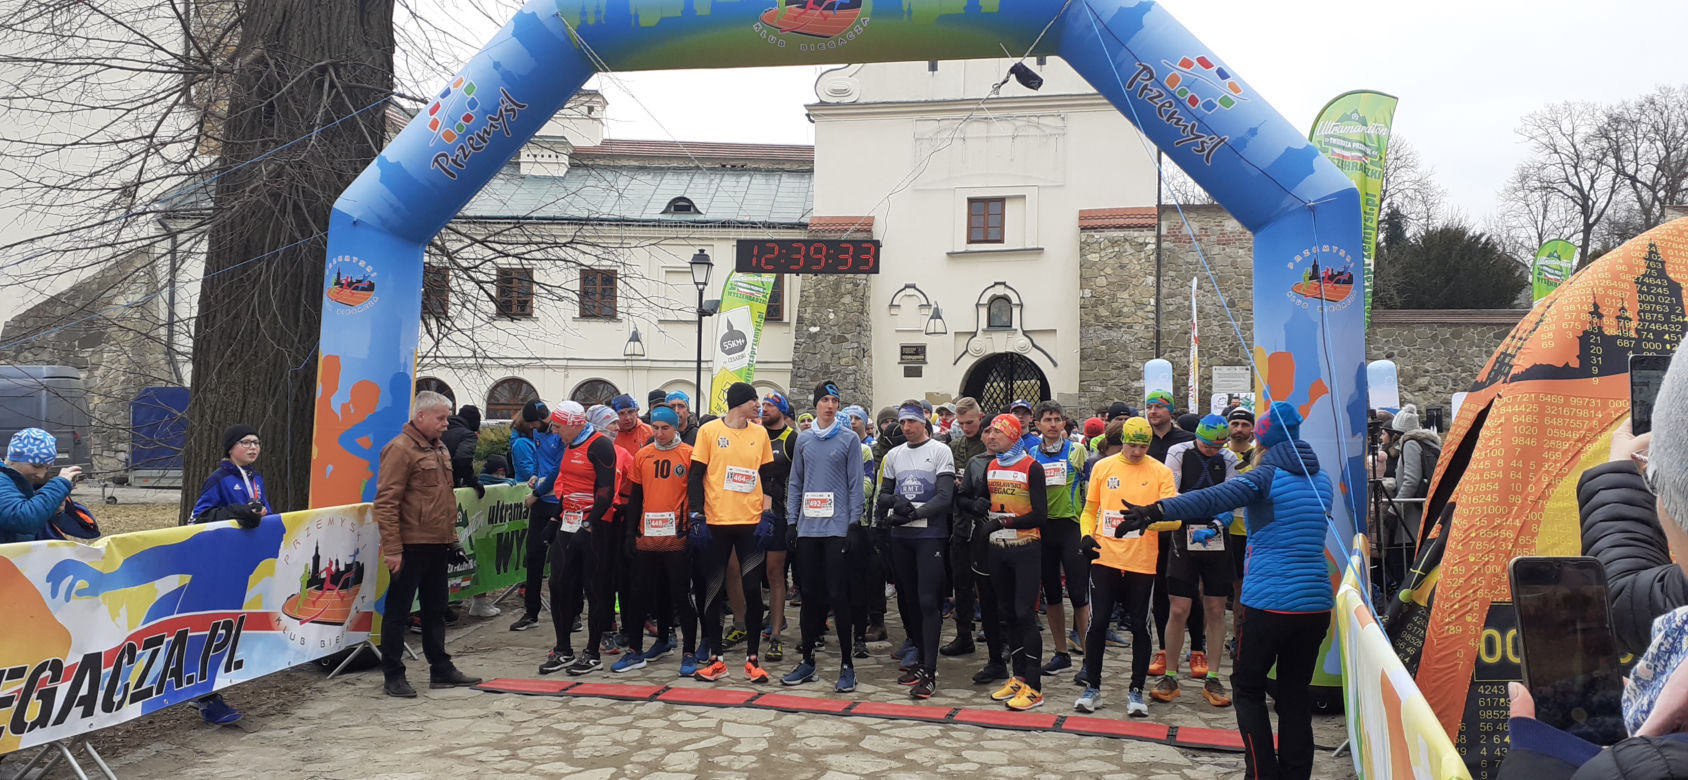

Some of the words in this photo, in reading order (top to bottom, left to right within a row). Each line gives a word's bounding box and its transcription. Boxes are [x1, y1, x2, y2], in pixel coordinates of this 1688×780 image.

[1126, 62, 1229, 165] Przemyśl
[431, 87, 528, 179] Przemyśl
[751, 243, 875, 270] 12:39:33
[1616, 338, 1636, 348] 687
[1642, 341, 1663, 350] 000
[1590, 345, 1603, 355] 20
[1590, 356, 1602, 365] 31
[1591, 366, 1599, 375] 9
[1512, 414, 1539, 424] 6465
[1513, 425, 1538, 435] 1020
[1497, 459, 1504, 468] 8
[653, 459, 671, 479] 10
[1483, 470, 1503, 480] 654
[1510, 472, 1522, 480] 64
[1511, 483, 1522, 492] 10
[1477, 684, 1506, 695] 4243
[1480, 722, 1494, 732] 56
[1496, 722, 1511, 732] 46
[1480, 734, 1487, 744] 2
[1493, 734, 1501, 744] 6
[1480, 747, 1488, 756] 4
[1480, 760, 1487, 768] 6
[1480, 770, 1488, 780] 9
